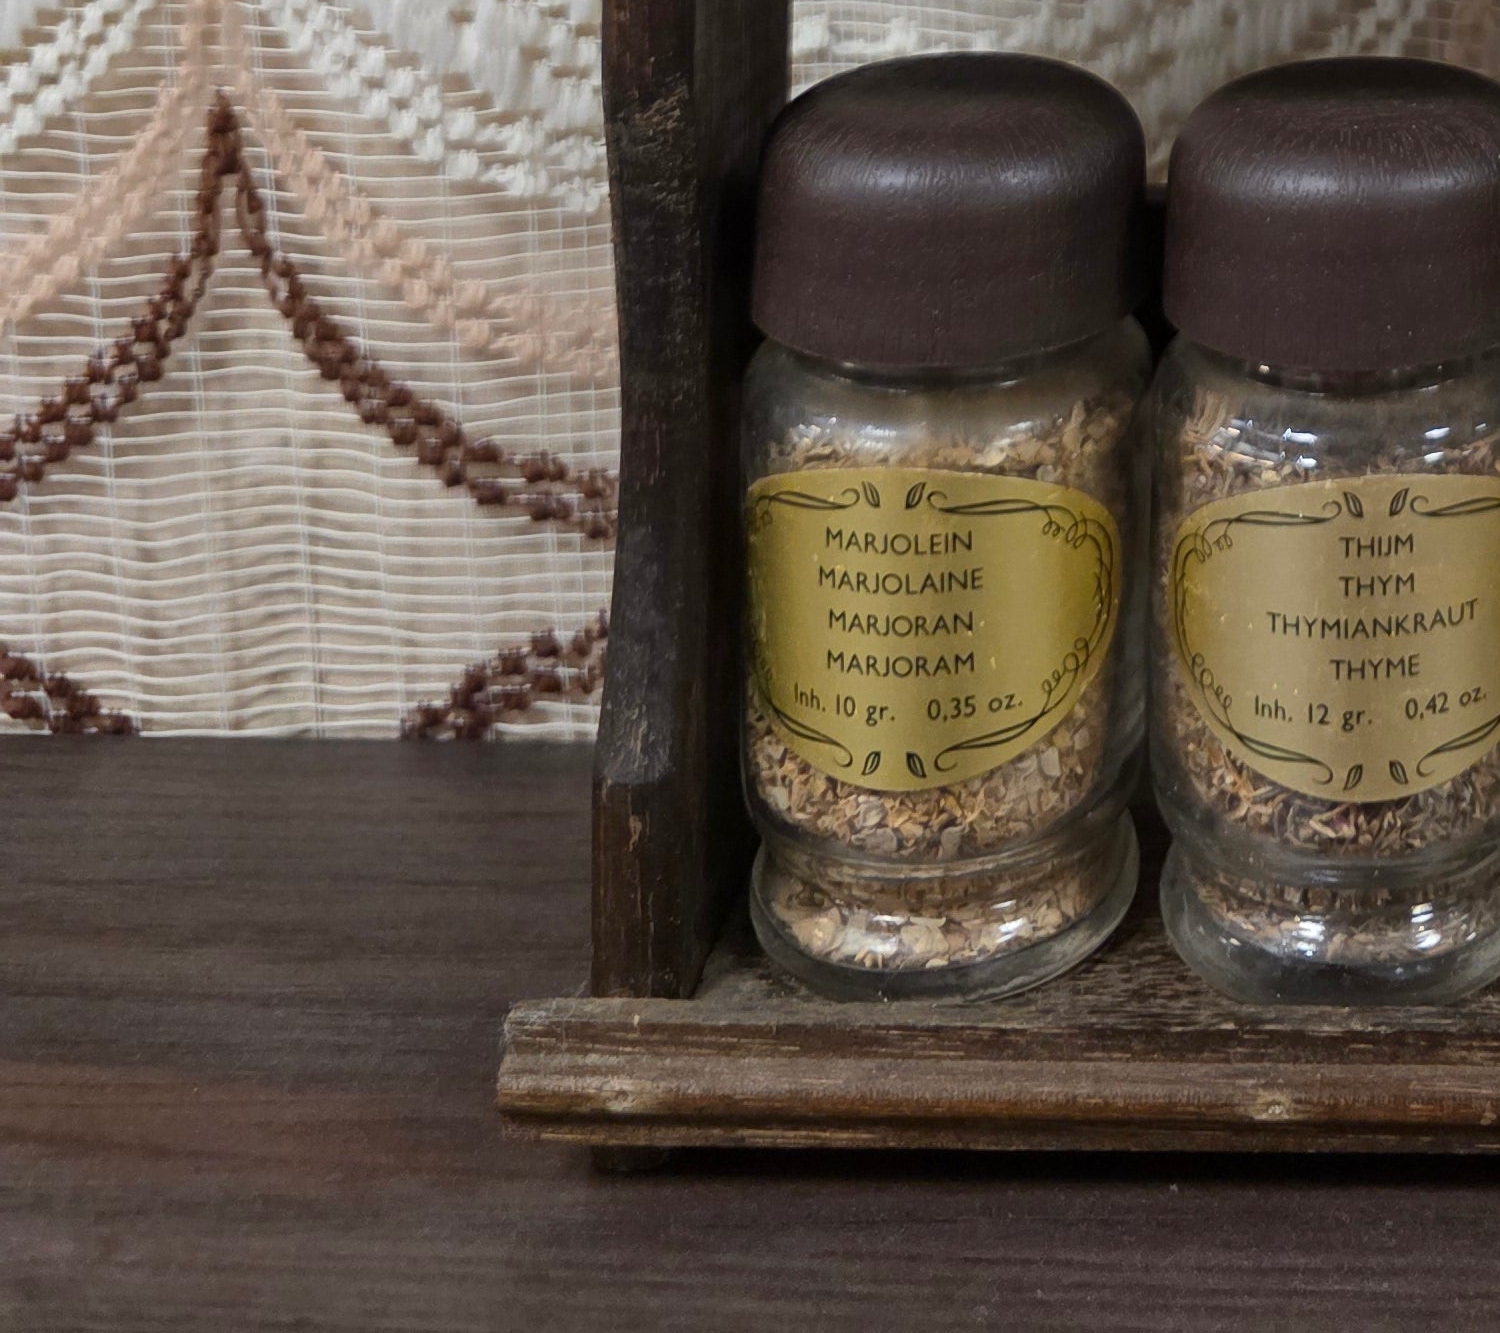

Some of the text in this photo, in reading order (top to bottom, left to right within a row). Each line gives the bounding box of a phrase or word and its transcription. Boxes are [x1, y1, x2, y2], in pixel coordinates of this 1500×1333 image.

[825, 526, 973, 556] MARJOLEIN
[1339, 533, 1414, 558] THIJM
[818, 565, 983, 595] MARJOLAINE
[1338, 573, 1415, 598] THYM
[828, 608, 974, 637] MARJORAN
[1266, 598, 1479, 639] THYMIANKRAUT
[826, 649, 975, 677] MARJORAM
[1330, 654, 1420, 681] THYME
[794, 683, 1023, 726] Inh. 10 gr. 0,35 oz.
[1254, 687, 1486, 733] Inh. 12 gr. 0,42 oz.
